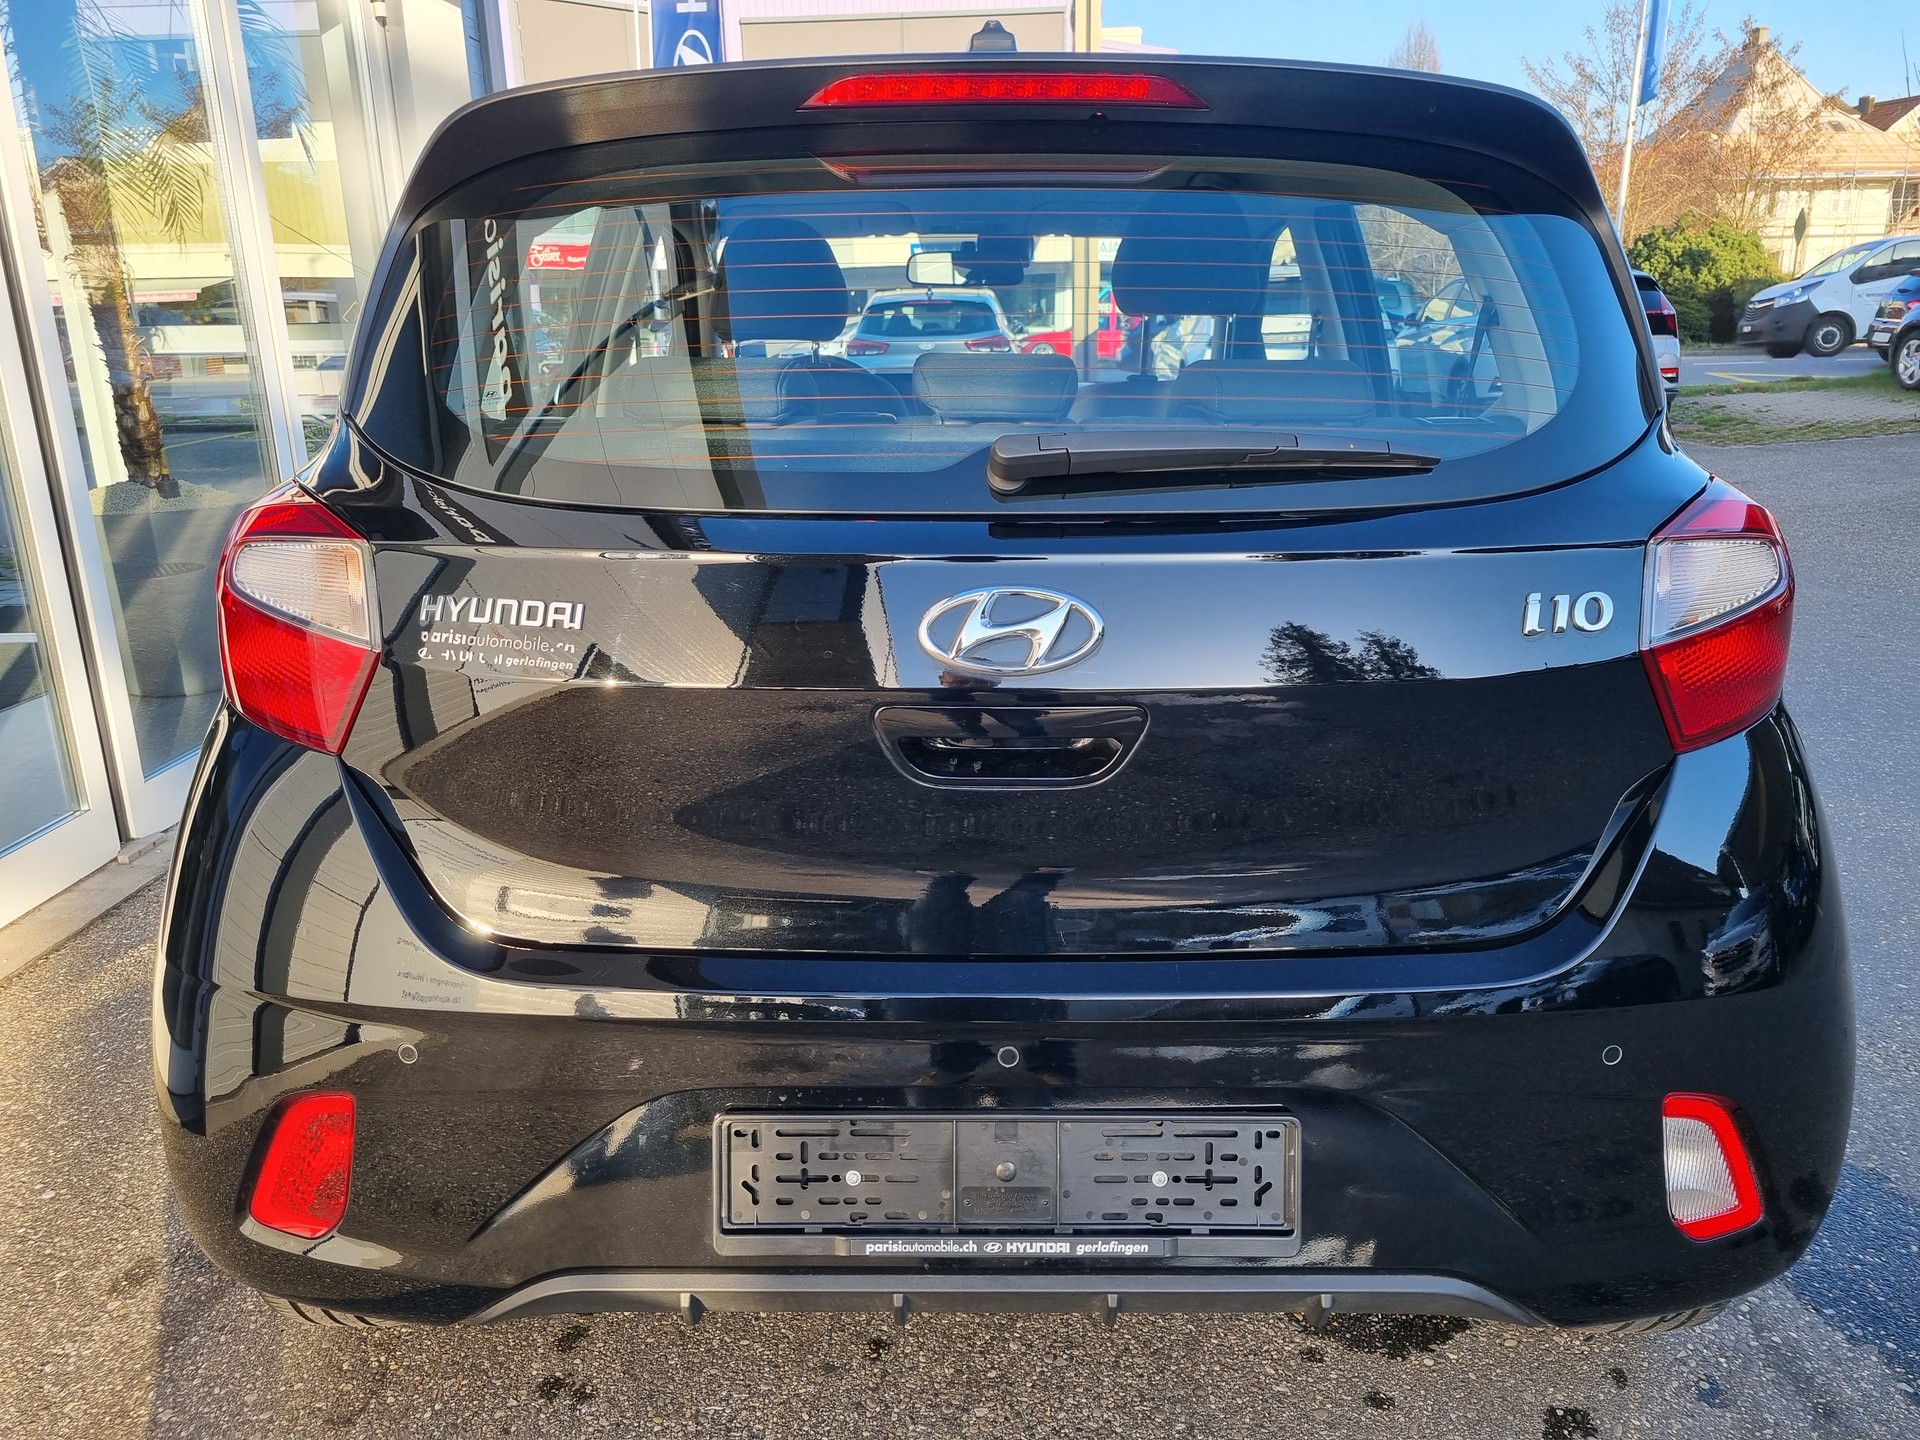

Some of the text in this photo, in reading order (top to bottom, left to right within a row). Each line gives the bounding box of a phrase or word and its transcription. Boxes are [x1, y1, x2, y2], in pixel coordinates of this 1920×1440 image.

[420, 594, 584, 630] HYUNDAI
[505, 655, 574, 671] gerlafingen
[866, 1240, 1149, 1255] parisiautomobile.ch HYUNDAI gerlafingen
